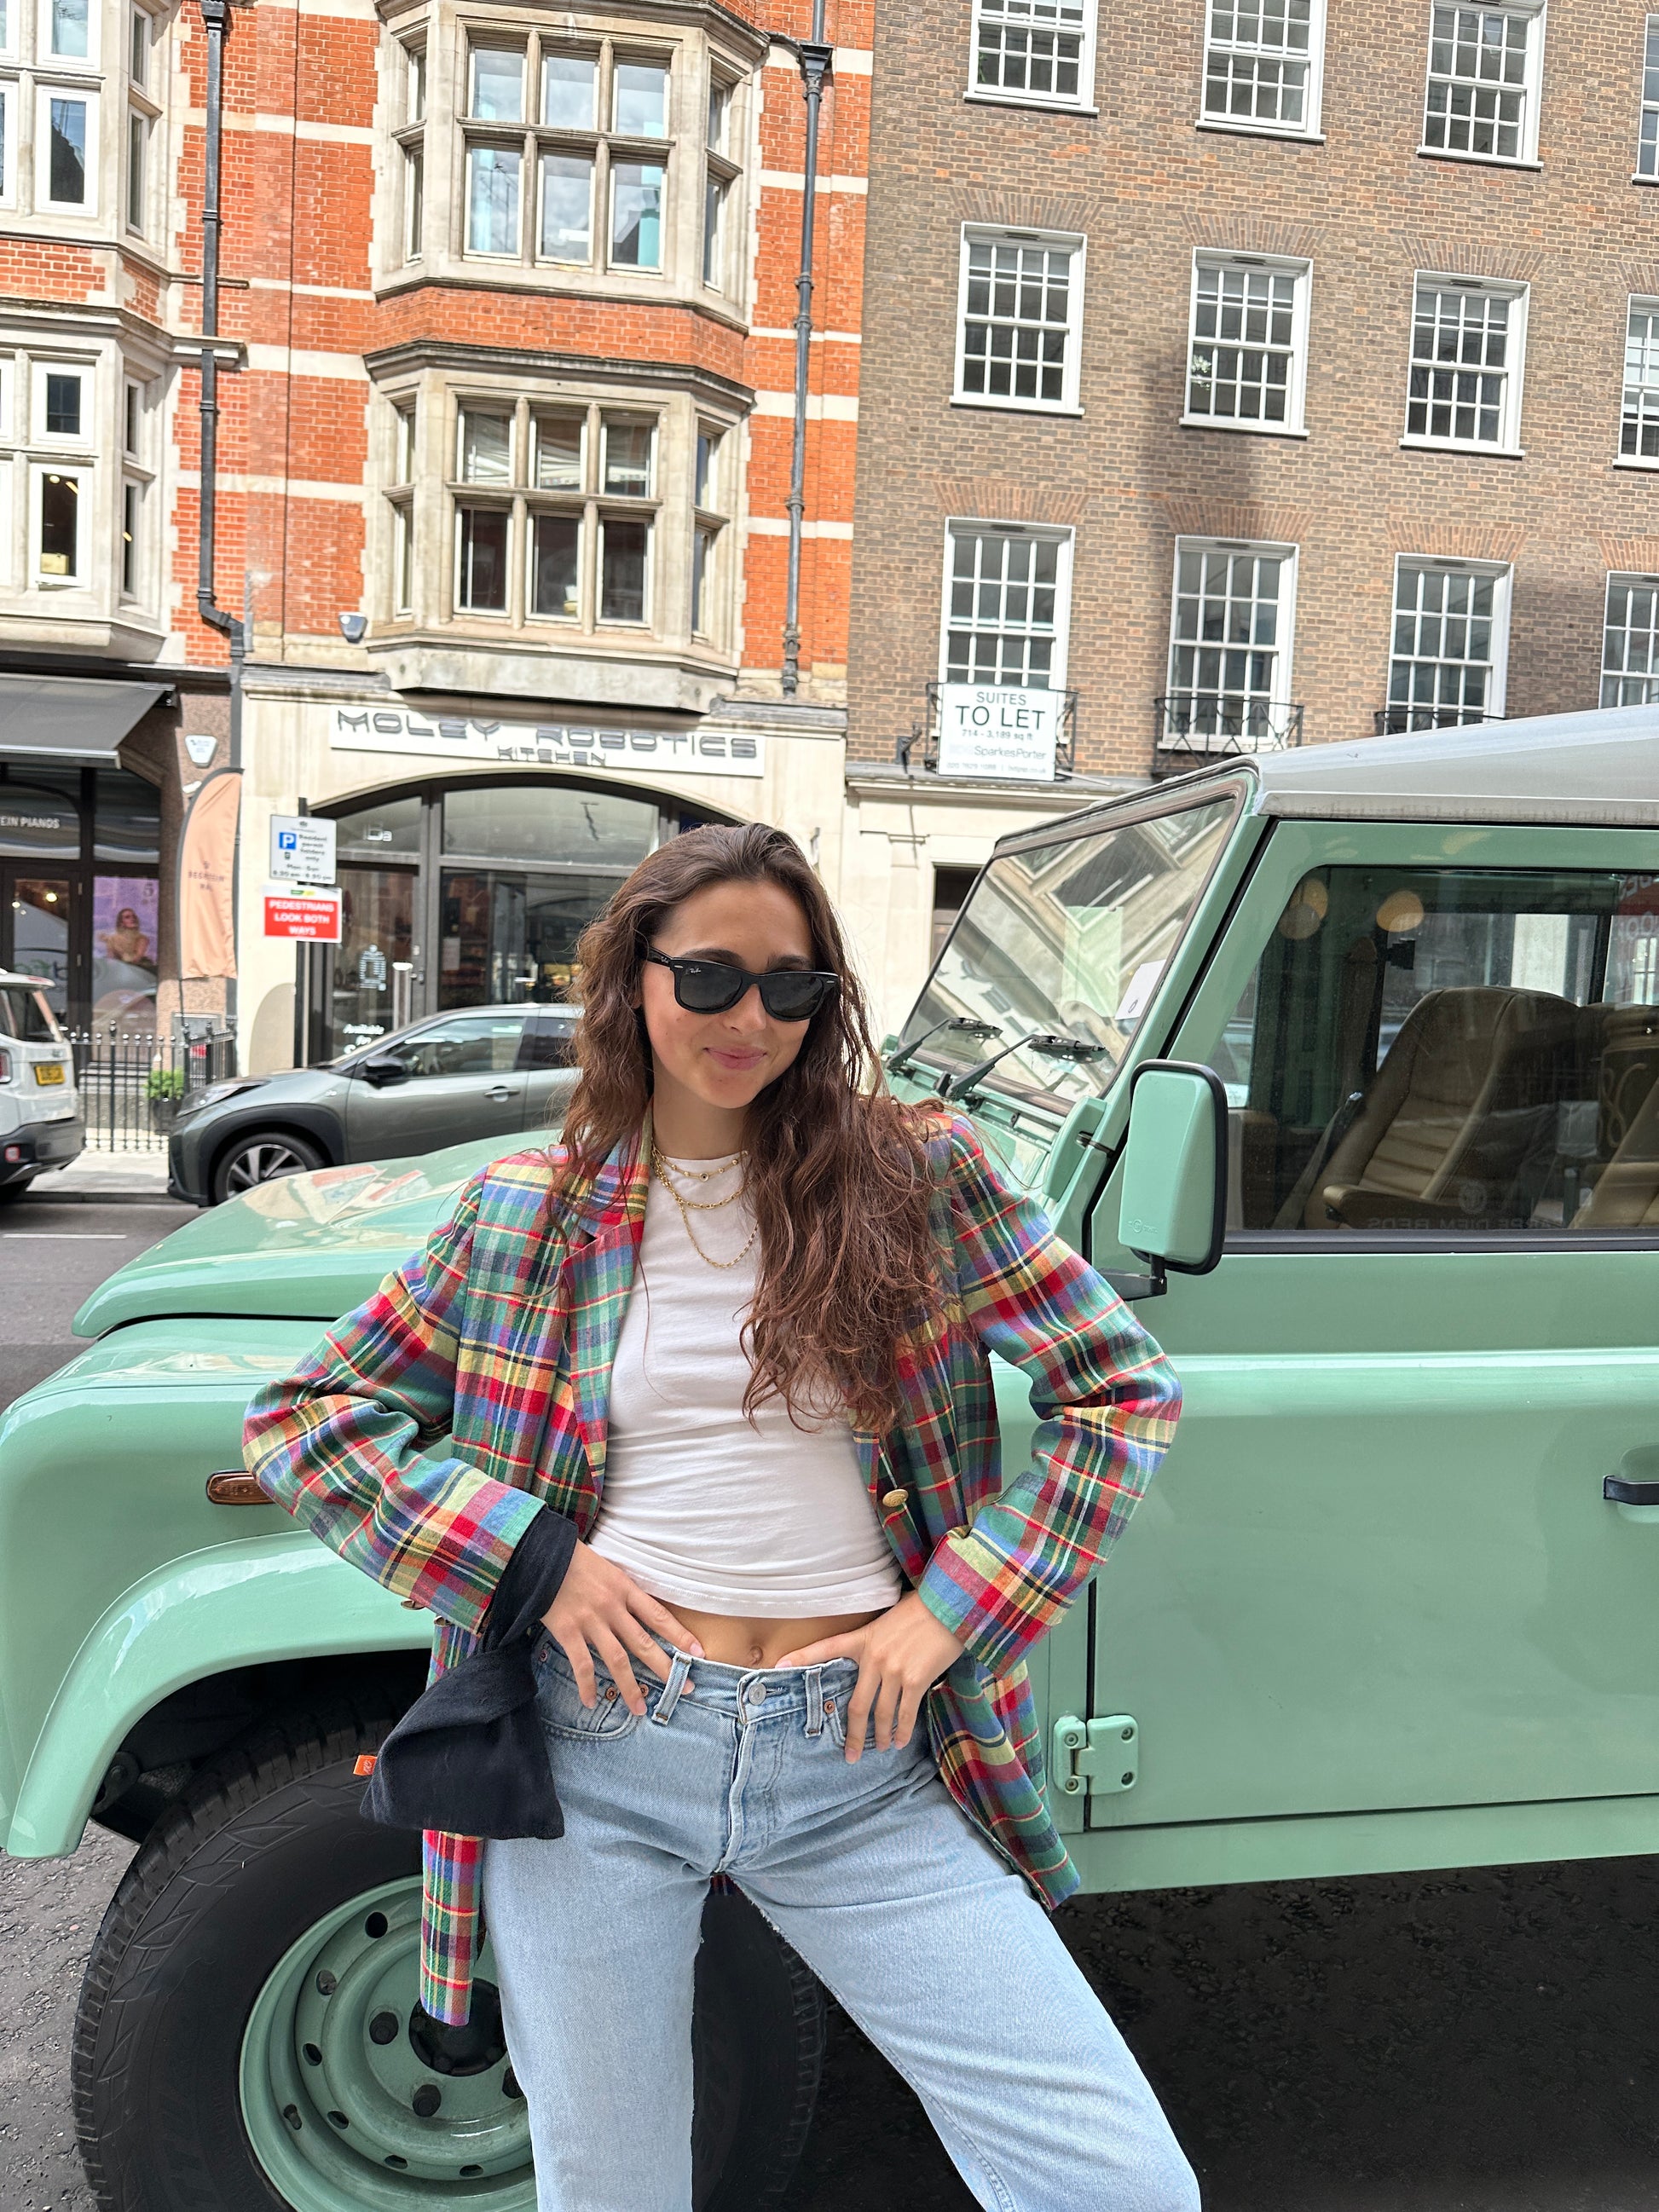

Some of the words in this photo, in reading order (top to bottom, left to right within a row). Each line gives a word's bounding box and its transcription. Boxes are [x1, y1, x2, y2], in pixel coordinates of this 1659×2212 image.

[976, 691, 1026, 706] SUITES
[955, 705, 990, 725] TO
[1001, 707, 1045, 730] LET
[338, 709, 501, 742] MOLEY
[536, 725, 756, 758] ROBOTICS
[498, 746, 606, 767] KITCHEN
[974, 745, 1046, 759] SparkesPorter
[0, 816, 19, 826] EIN
[20, 817, 60, 829] PIANOS
[282, 835, 295, 849] P
[269, 899, 334, 912] PEDESTRIANS
[274, 913, 302, 922] LOOK
[303, 914, 330, 924] BOTH
[288, 926, 316, 935] WAYS
